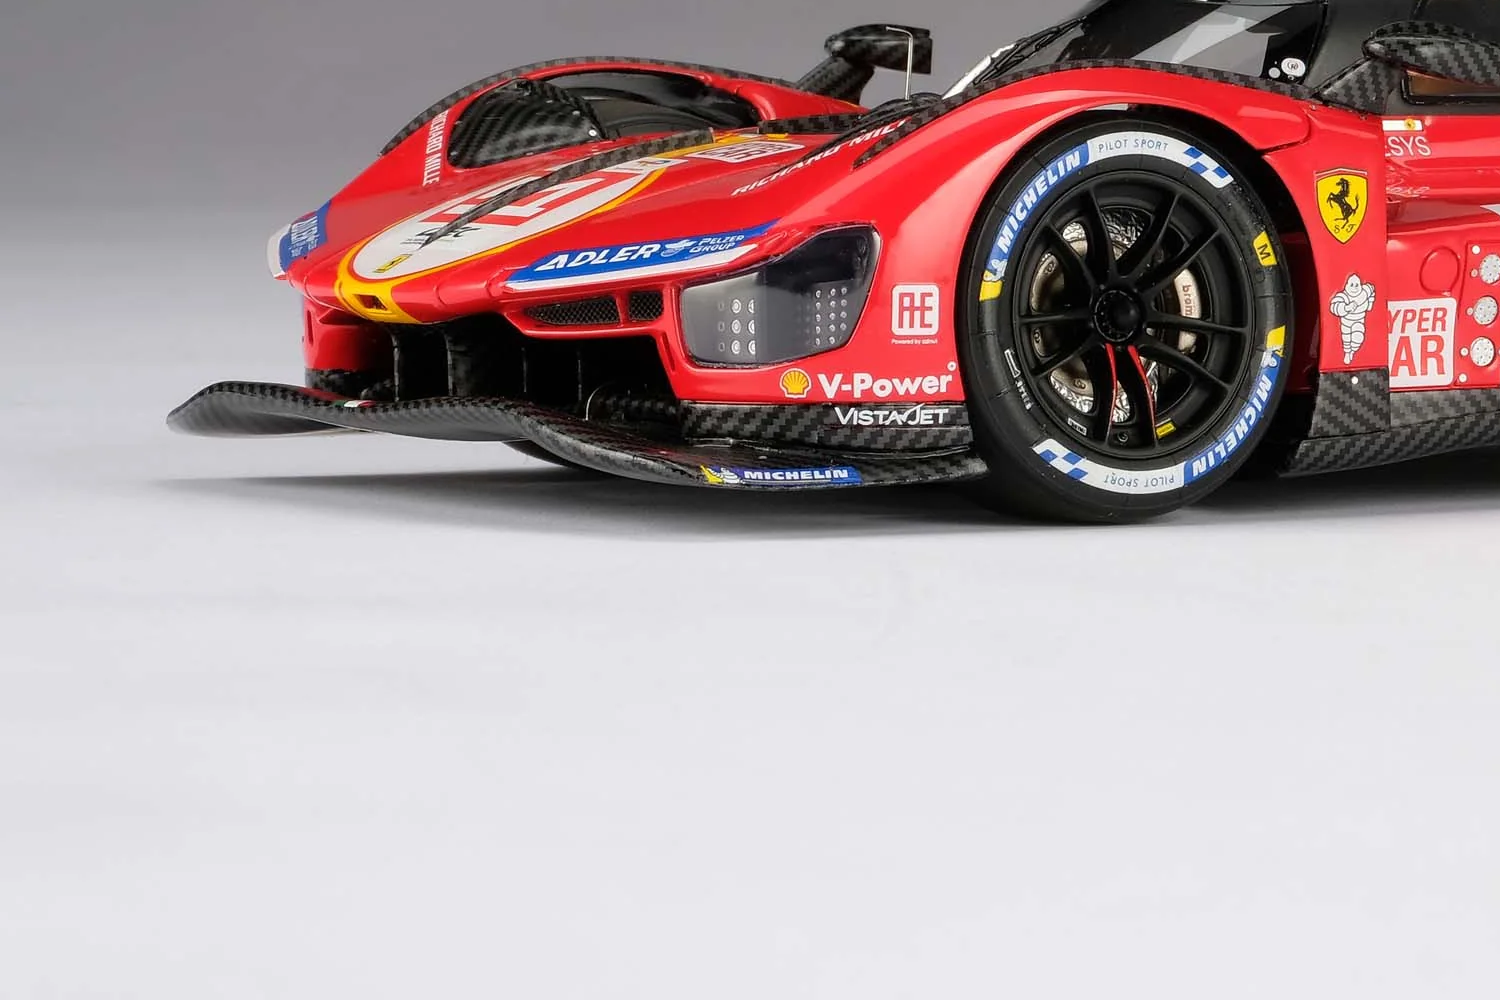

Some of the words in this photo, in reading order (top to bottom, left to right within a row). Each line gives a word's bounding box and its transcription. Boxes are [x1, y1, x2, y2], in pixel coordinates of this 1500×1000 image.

[1098, 138, 1129, 153] PILOT
[1133, 138, 1169, 152] SPORT
[1385, 135, 1432, 157] SYS
[998, 150, 1082, 254] MICHELIN
[689, 242, 736, 253] GROUP
[697, 235, 745, 246] PELZER
[534, 243, 662, 272] ADLER
[1257, 242, 1270, 261] M
[1388, 307, 1448, 334] YPER
[1391, 335, 1446, 377] AR
[817, 373, 953, 399] V-Power
[1192, 375, 1272, 478] MICHELIN
[743, 468, 849, 480] MICHELIN
[1103, 473, 1142, 488] SPORT
[1143, 473, 1175, 488] PILOT
